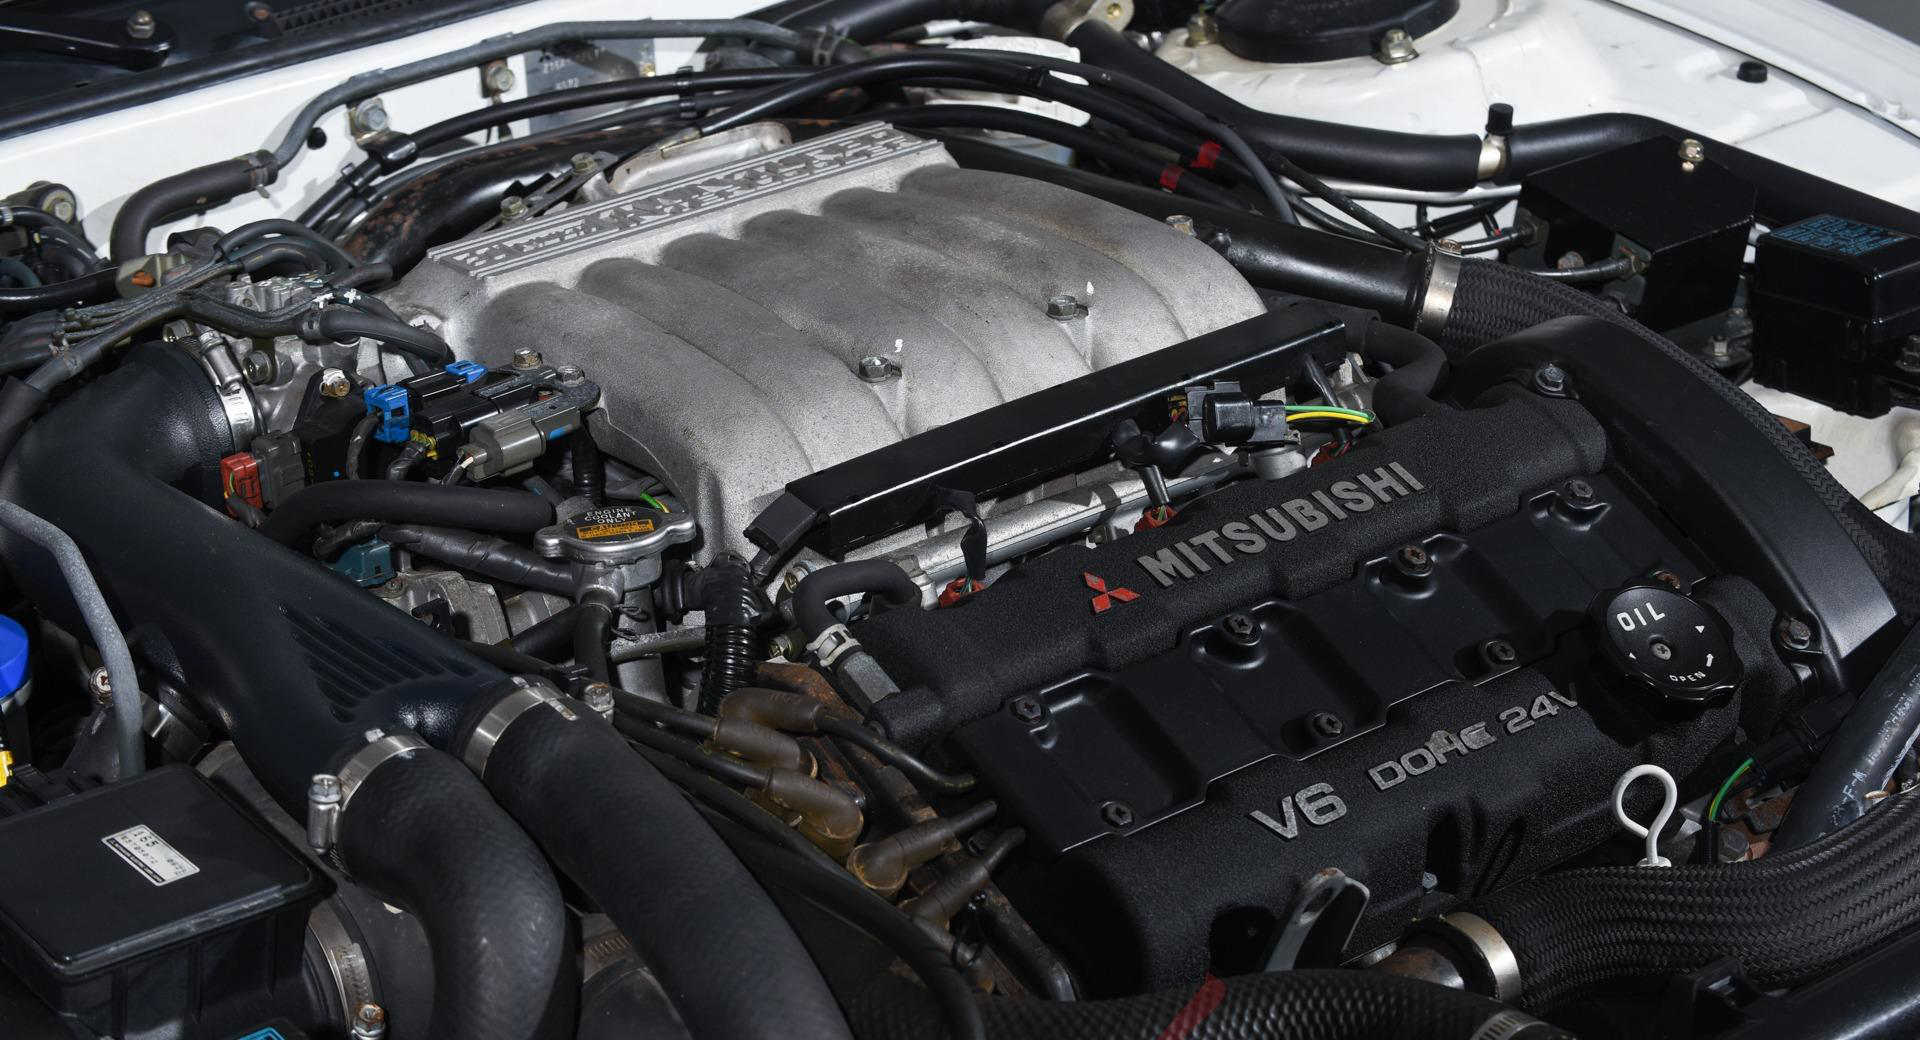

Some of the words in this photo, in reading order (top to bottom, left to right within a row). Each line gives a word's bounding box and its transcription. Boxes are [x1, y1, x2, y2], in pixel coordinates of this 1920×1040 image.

[584, 510, 637, 521] COOLANT
[586, 507, 632, 516] ENGINE
[1136, 461, 1425, 588] MITSUBISHI
[1616, 602, 1666, 632] OIL
[1669, 670, 1706, 682] OPEN
[1250, 782, 1347, 839] V6
[1499, 684, 1578, 734] 24V
